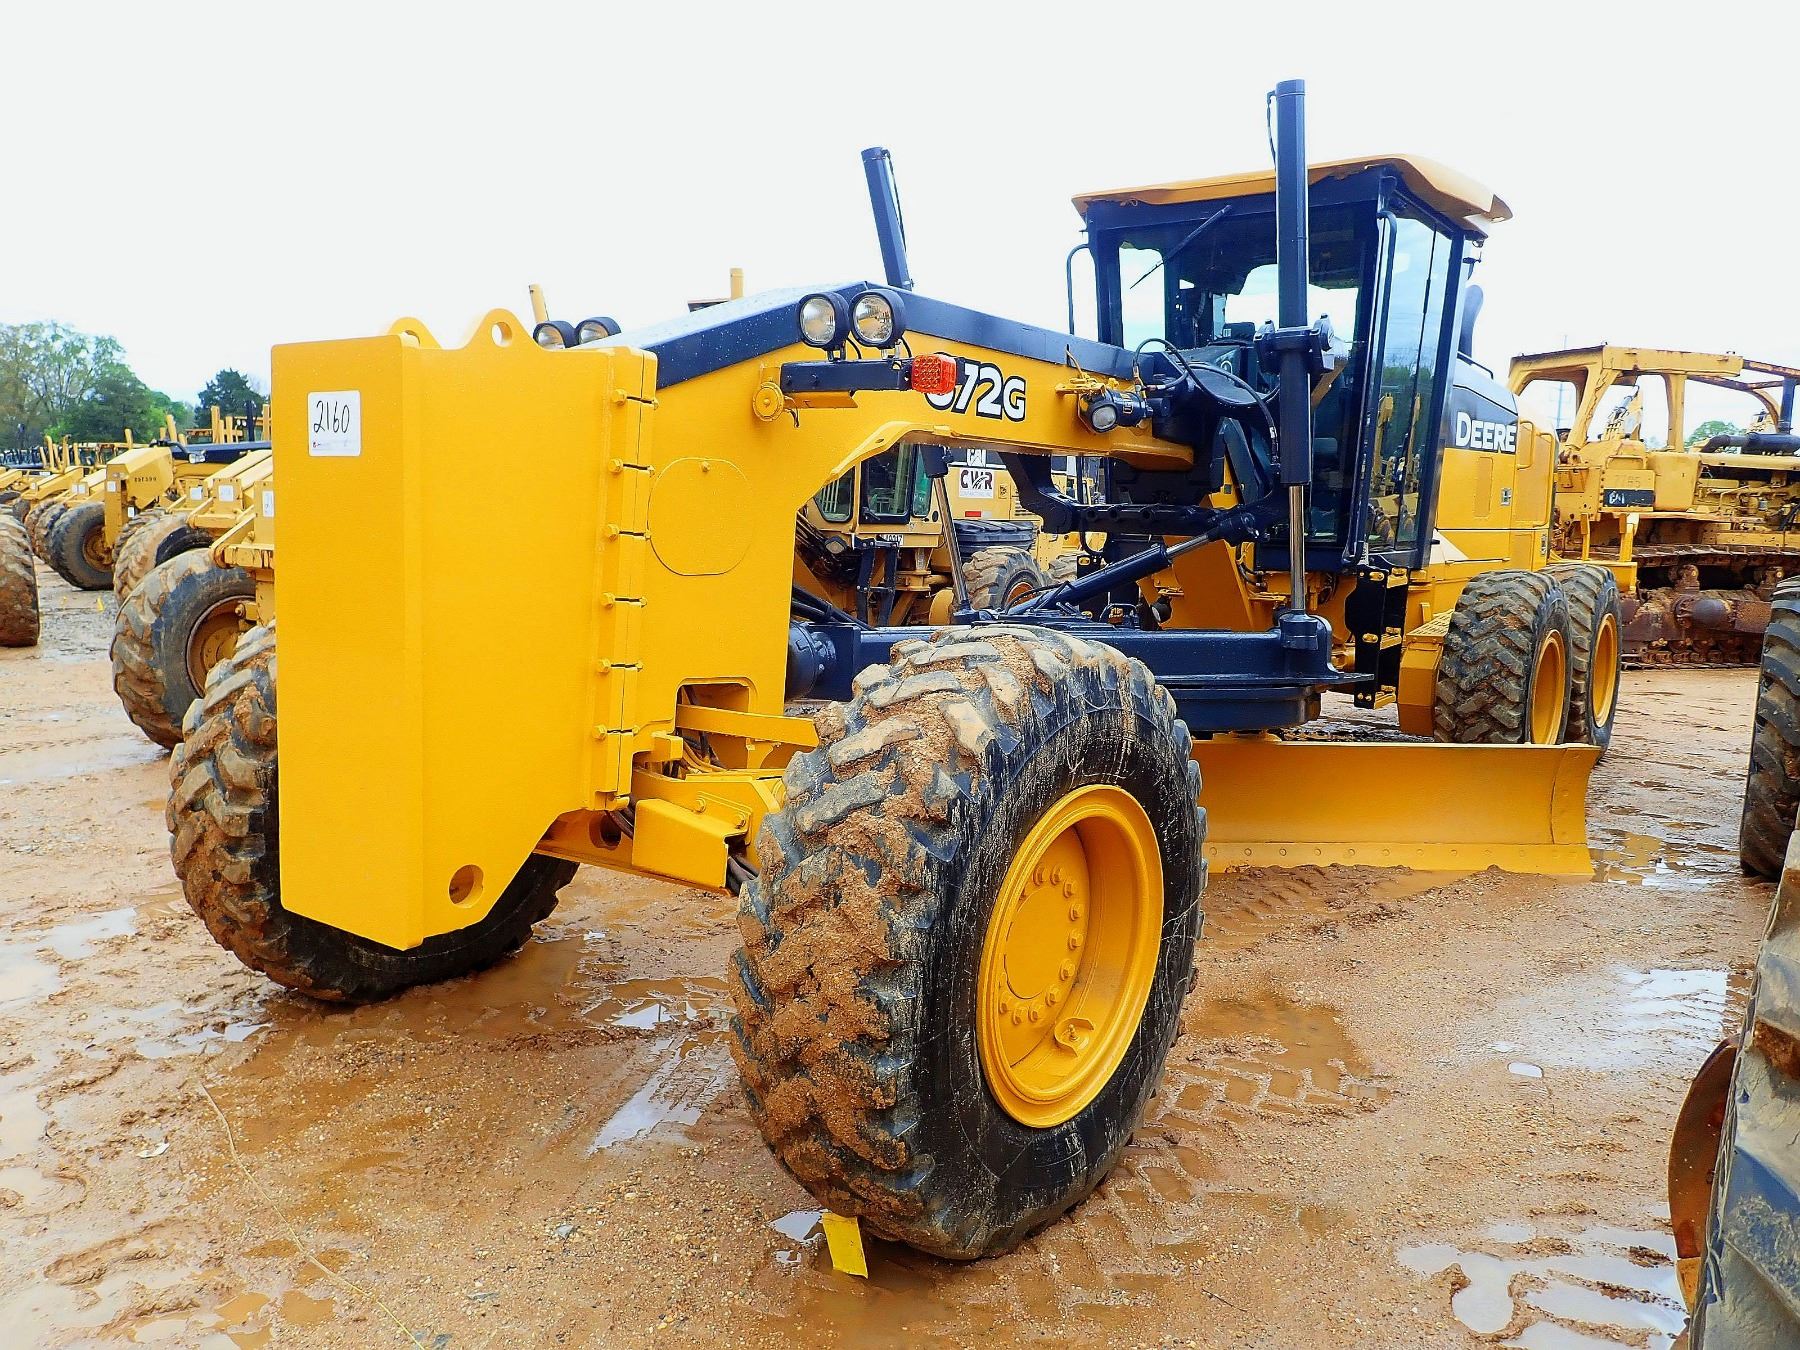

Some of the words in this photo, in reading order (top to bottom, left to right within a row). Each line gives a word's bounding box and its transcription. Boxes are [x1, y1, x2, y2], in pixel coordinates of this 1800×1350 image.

[313, 400, 350, 434] 2160
[1455, 411, 1517, 452] DEERE
[960, 469, 993, 490] CWR
